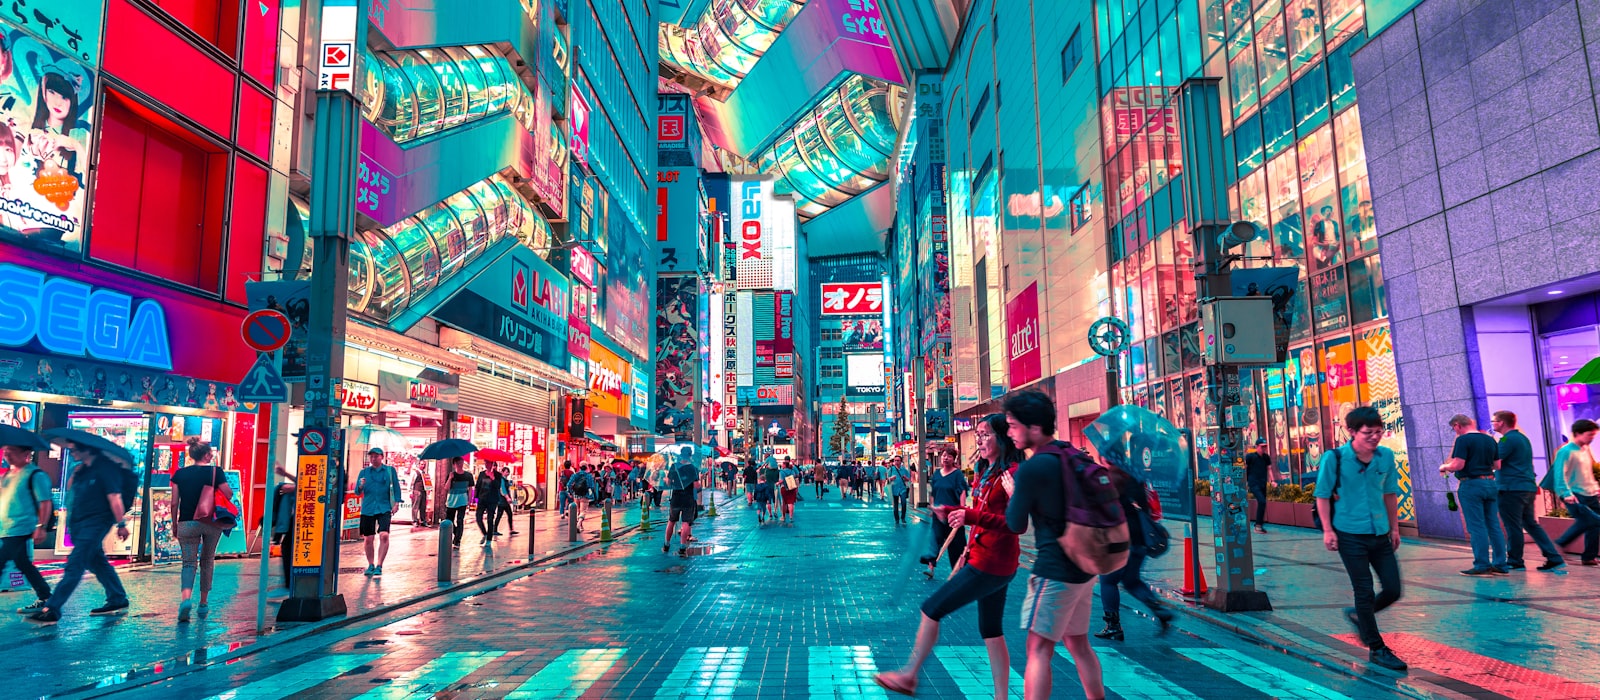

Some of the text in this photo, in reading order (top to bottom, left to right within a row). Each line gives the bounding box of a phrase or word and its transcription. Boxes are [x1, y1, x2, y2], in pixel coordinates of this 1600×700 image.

[359, 162, 390, 194] カメラ
[0, 262, 173, 370] SEGA
[532, 271, 567, 321] LABI
[531, 307, 567, 337] AKIHABARA
[1011, 317, 1034, 358] atré
[301, 463, 318, 562] 路上喫煙禁止です。
